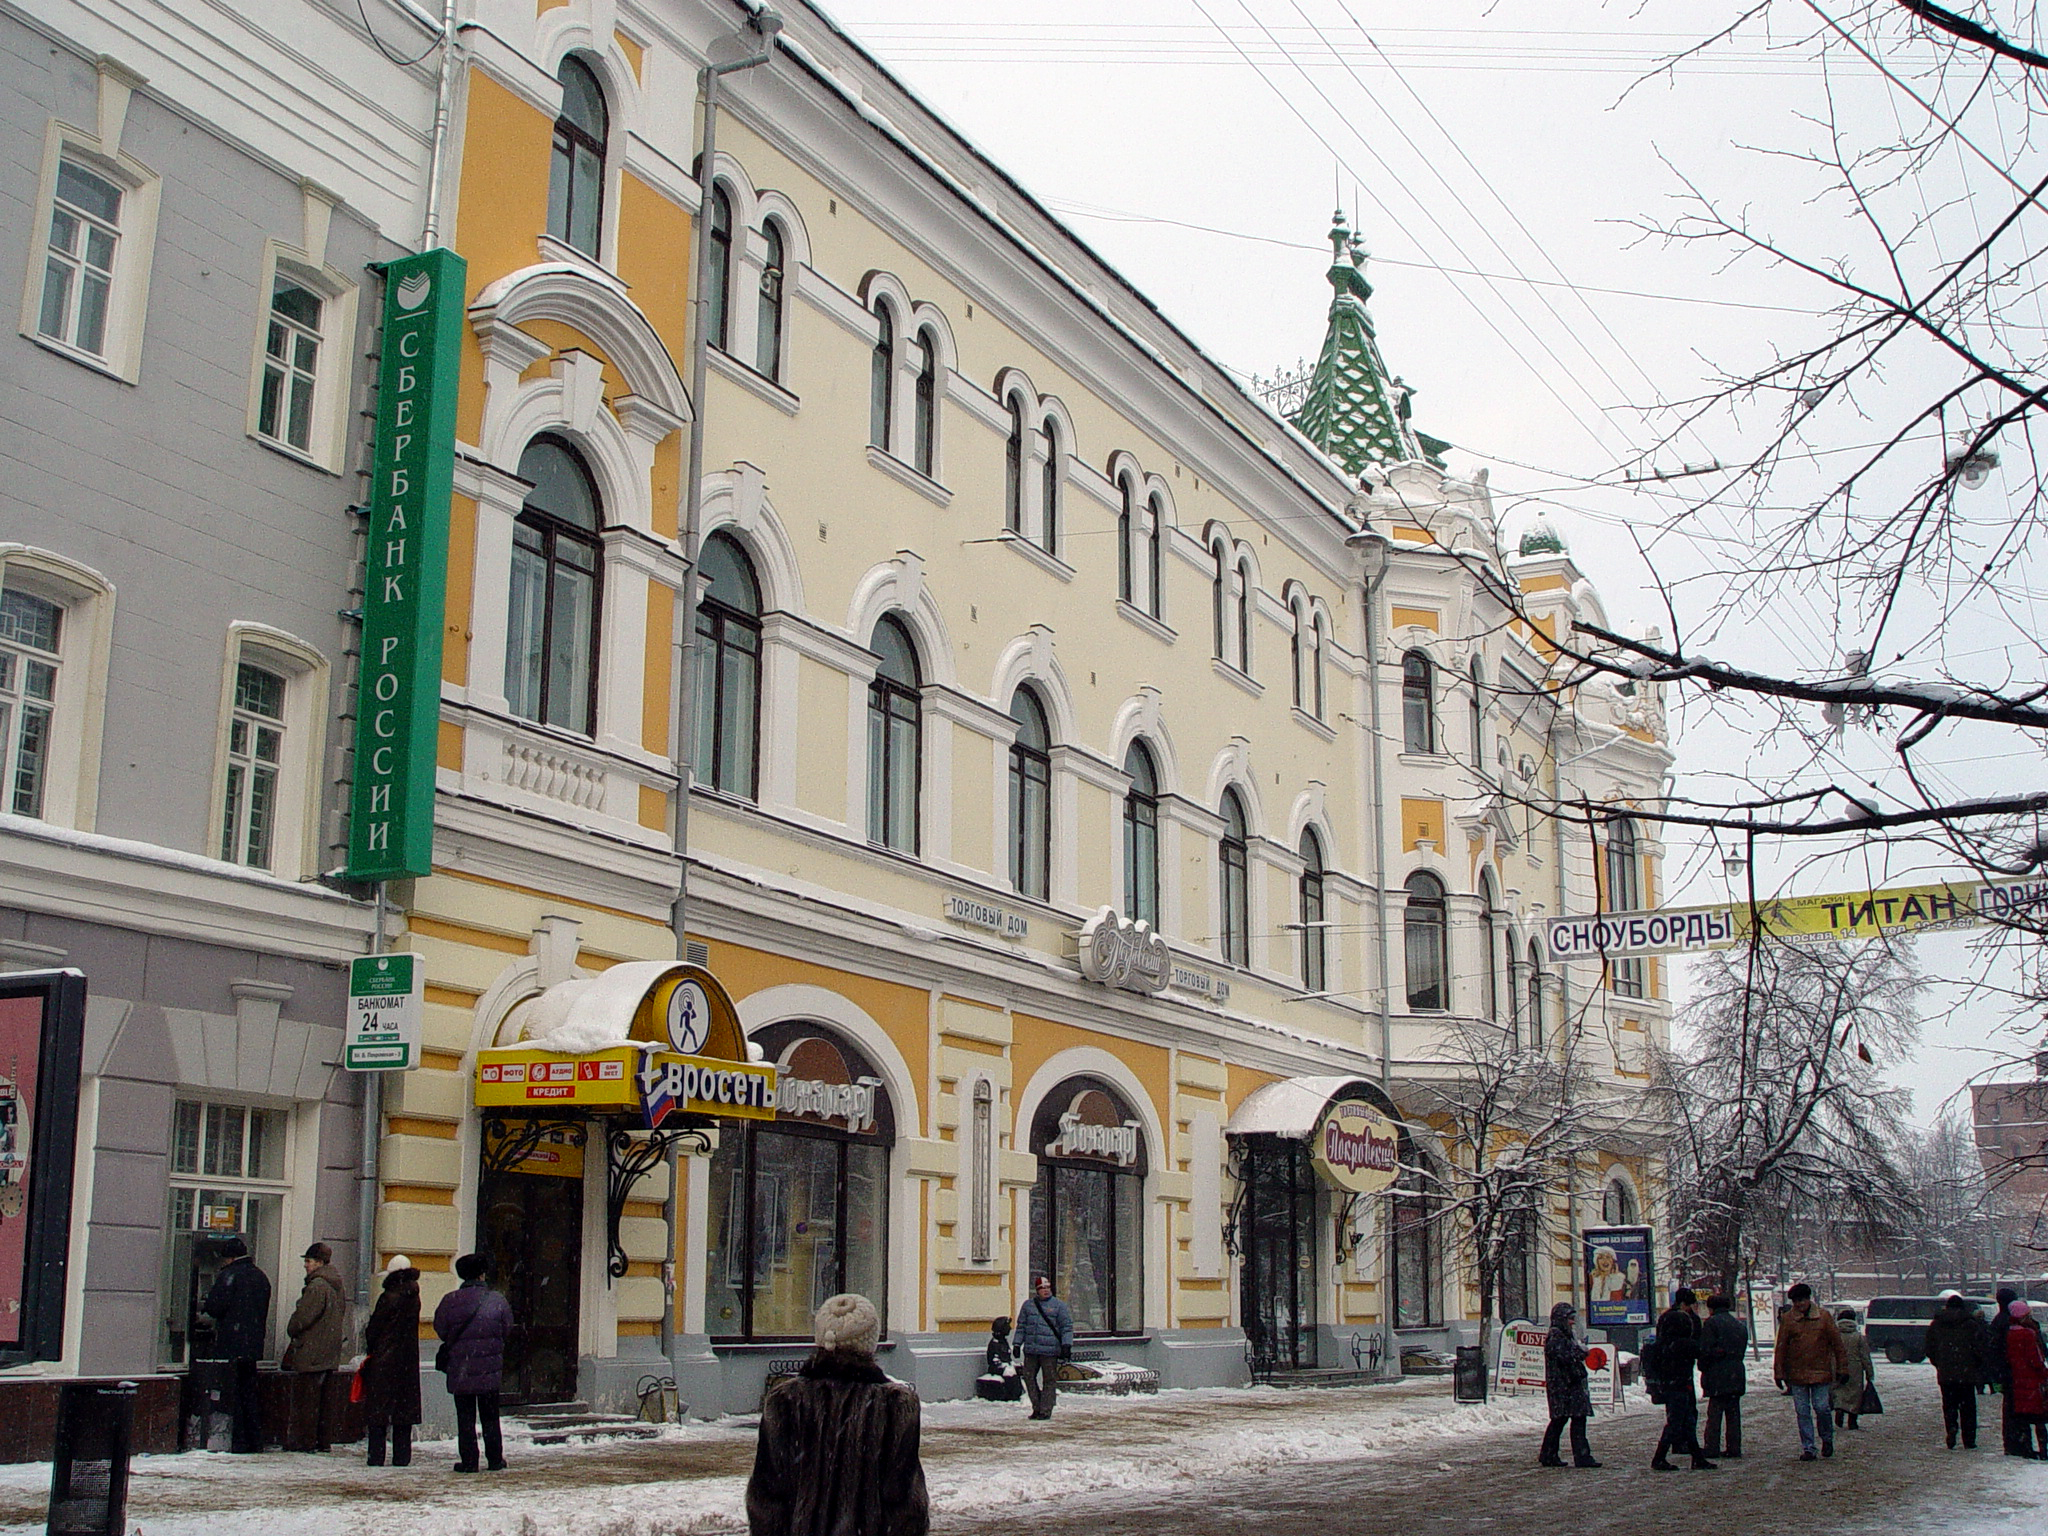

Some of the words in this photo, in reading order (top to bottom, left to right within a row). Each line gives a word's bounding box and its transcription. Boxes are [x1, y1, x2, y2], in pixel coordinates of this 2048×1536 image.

[382, 331, 421, 604] СБЕРБАНК
[367, 637, 400, 853] РОССИИ
[951, 897, 1003, 927] ТОРГОВЫЙ
[1007, 913, 1028, 935] ДОМ
[1796, 895, 1851, 907] МАГАЗИН
[1820, 893, 1957, 929] ТИТАН
[1979, 883, 2048, 918] ГОРН
[1552, 912, 1732, 952] СНОУБОРДЫ
[1840, 927, 1858, 939] 14
[1174, 968, 1211, 991] ТОРГОВЫЙ
[1216, 980, 1230, 997] ДОМ
[358, 996, 405, 1010] БАНКОМАТ
[362, 1012, 378, 1032] 24
[382, 1022, 399, 1031] ЧАСА
[503, 1069, 524, 1077] ФОТО
[636, 1047, 777, 1110] Евросеть
[532, 1087, 569, 1097] КРЕДИТ
[1327, 1121, 1395, 1171] Покровский
